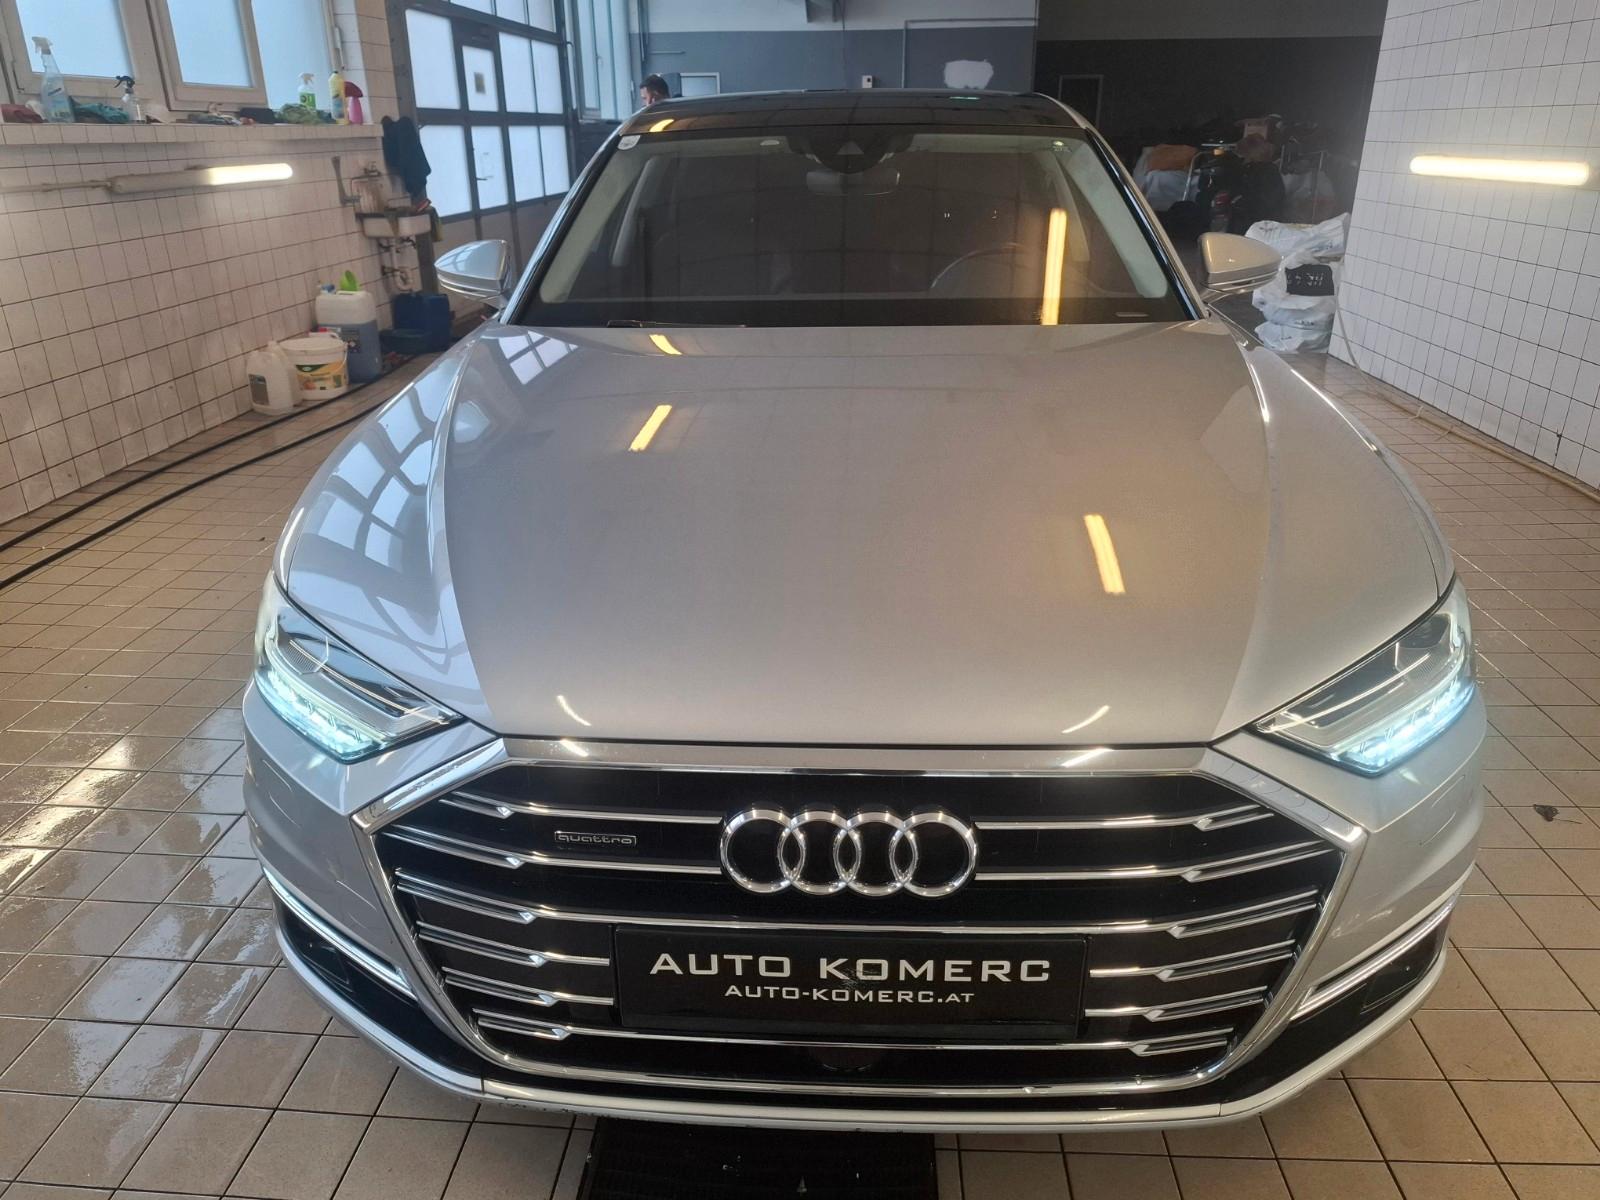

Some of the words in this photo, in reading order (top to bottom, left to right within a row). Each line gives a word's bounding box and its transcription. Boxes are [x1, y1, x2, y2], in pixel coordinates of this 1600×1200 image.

[557, 833, 634, 845] quattro
[649, 953, 791, 978] AUTO
[819, 957, 1050, 982] KOMERC
[724, 984, 975, 1003] AUTO-KOMERC.AT
